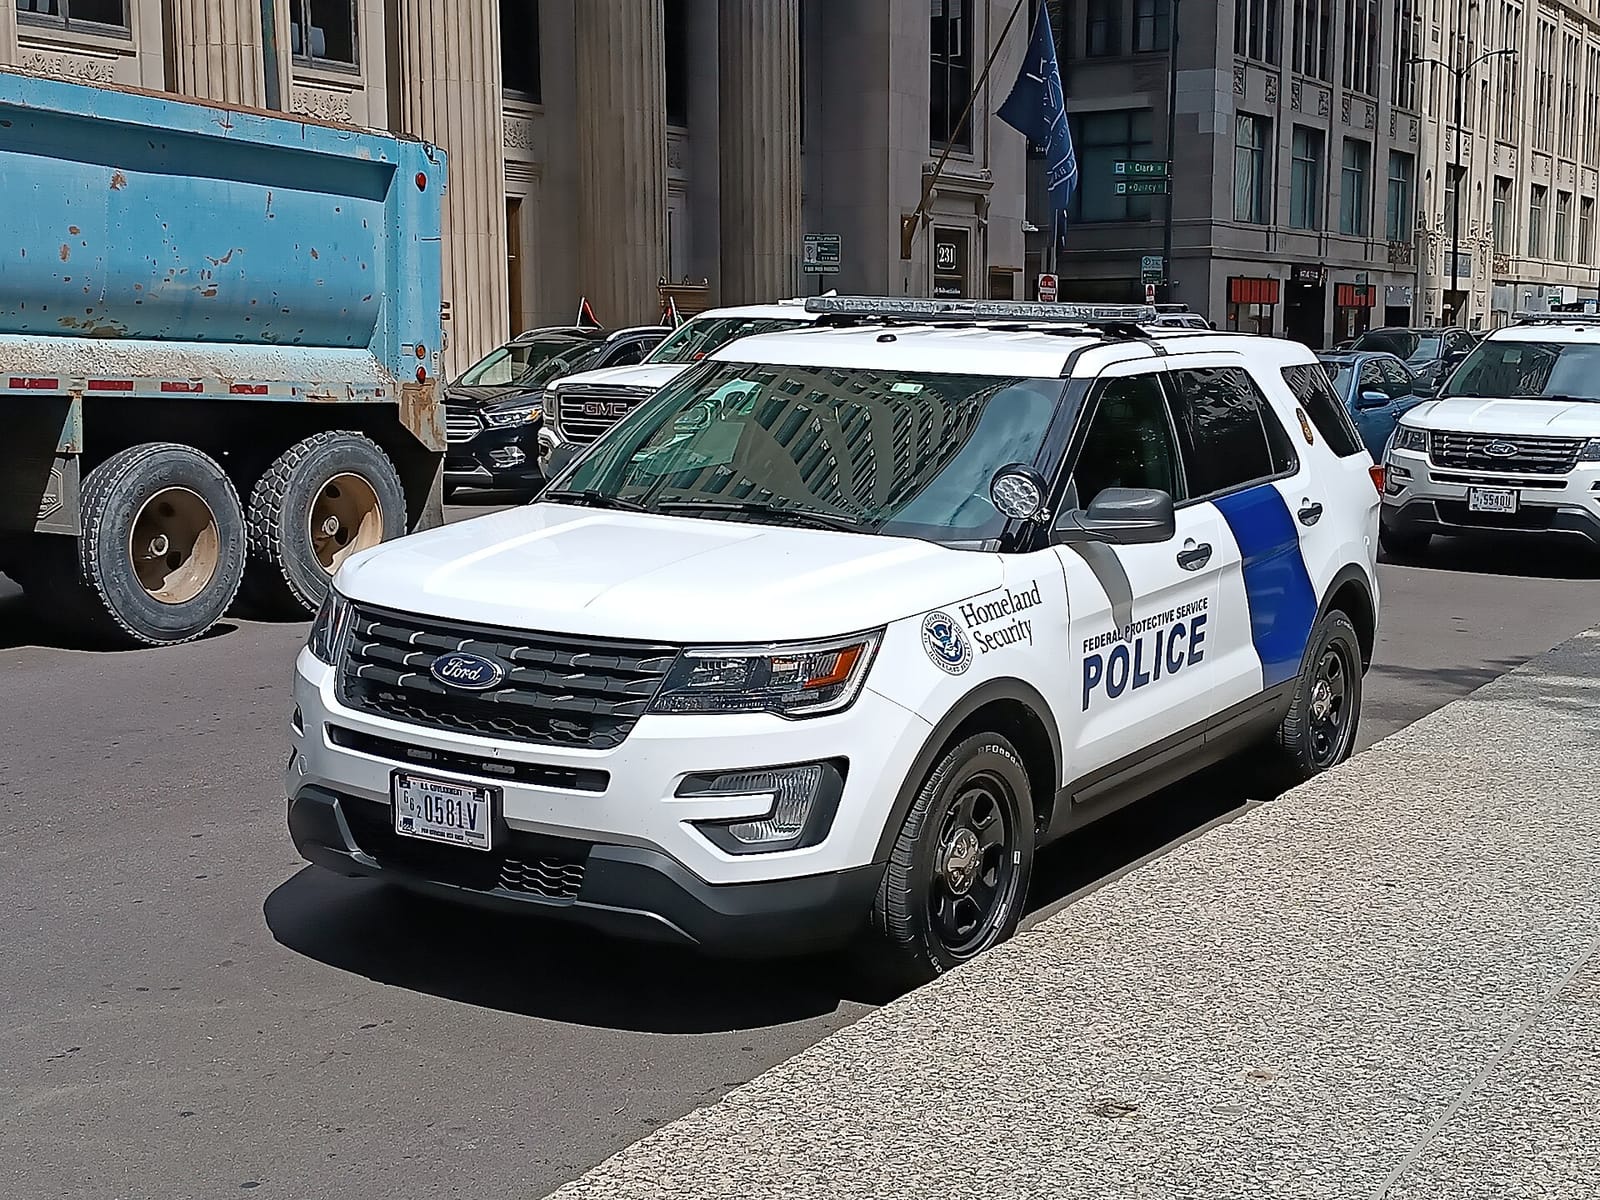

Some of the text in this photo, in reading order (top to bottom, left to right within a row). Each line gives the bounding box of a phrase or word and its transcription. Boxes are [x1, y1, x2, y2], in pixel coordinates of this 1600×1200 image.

[1135, 163, 1154, 172] Clark
[939, 247, 953, 263] 231
[584, 401, 627, 416] GMC
[959, 580, 1042, 628] Homeland
[973, 618, 1032, 654] Security
[1083, 597, 1208, 653] FEDERAL PROTECTIVE SERVICE
[442, 658, 483, 680] Ford
[1082, 613, 1207, 712] POLICE
[424, 795, 477, 831] 0581V
